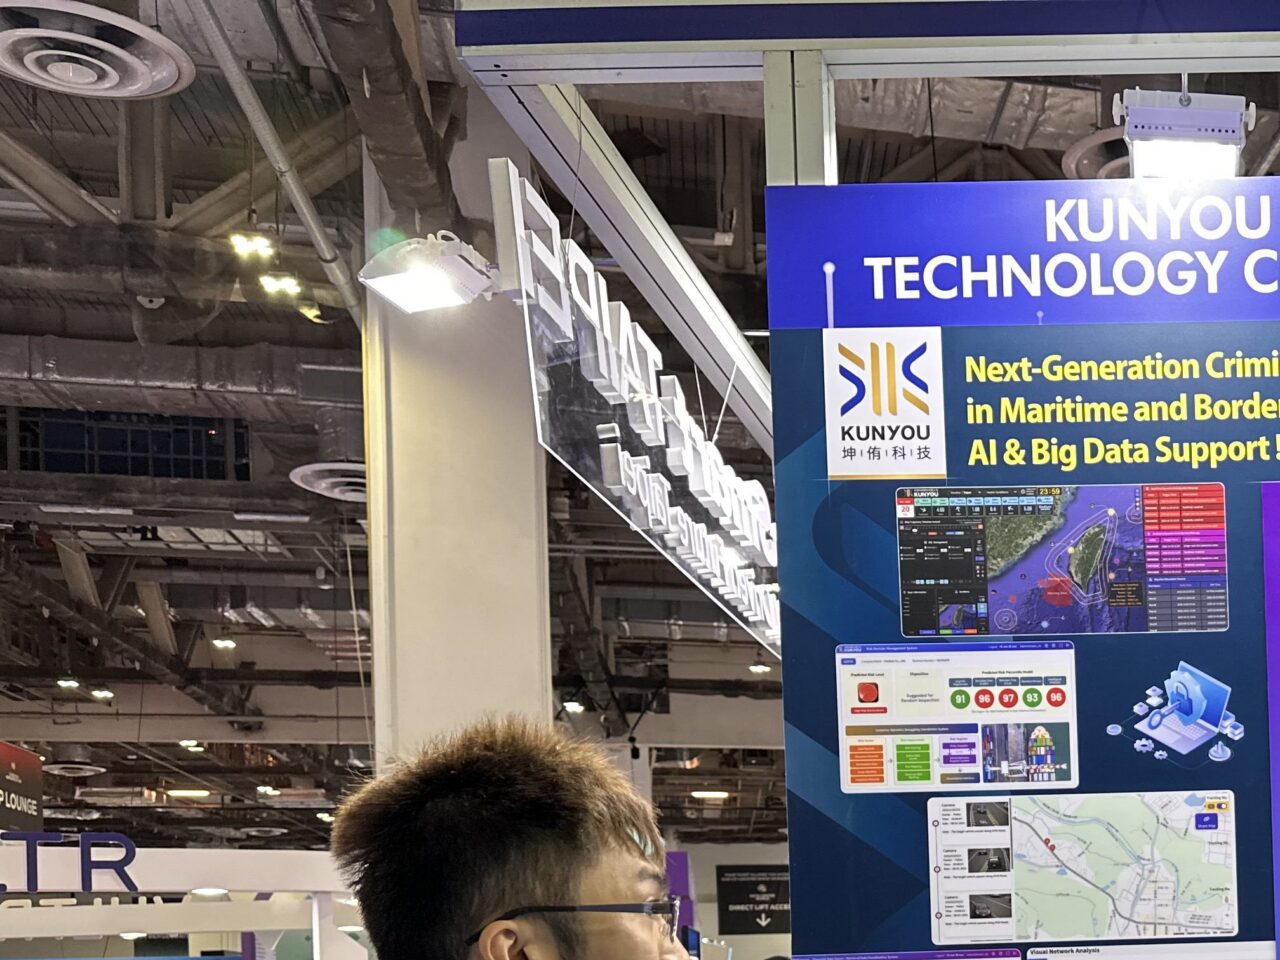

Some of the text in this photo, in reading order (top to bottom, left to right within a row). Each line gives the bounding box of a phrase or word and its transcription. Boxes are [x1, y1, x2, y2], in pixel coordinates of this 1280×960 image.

[1045, 197, 1270, 241] KUNYOU
[864, 250, 1230, 300] TECHNOLOGY
[966, 352, 1198, 383] Next-Generation
[967, 399, 993, 424] in
[1000, 395, 1126, 422] Maritime
[1133, 394, 1188, 420] and
[840, 425, 930, 442] KUNYOU
[968, 441, 997, 464] AI
[1003, 441, 1025, 464] &
[1031, 438, 1076, 470] Big
[1083, 436, 1150, 463] Data
[1039, 488, 1060, 496] 23:59
[956, 693, 1062, 704] 91 96 97 93 96
[6, 793, 37, 815] LOUNGE
